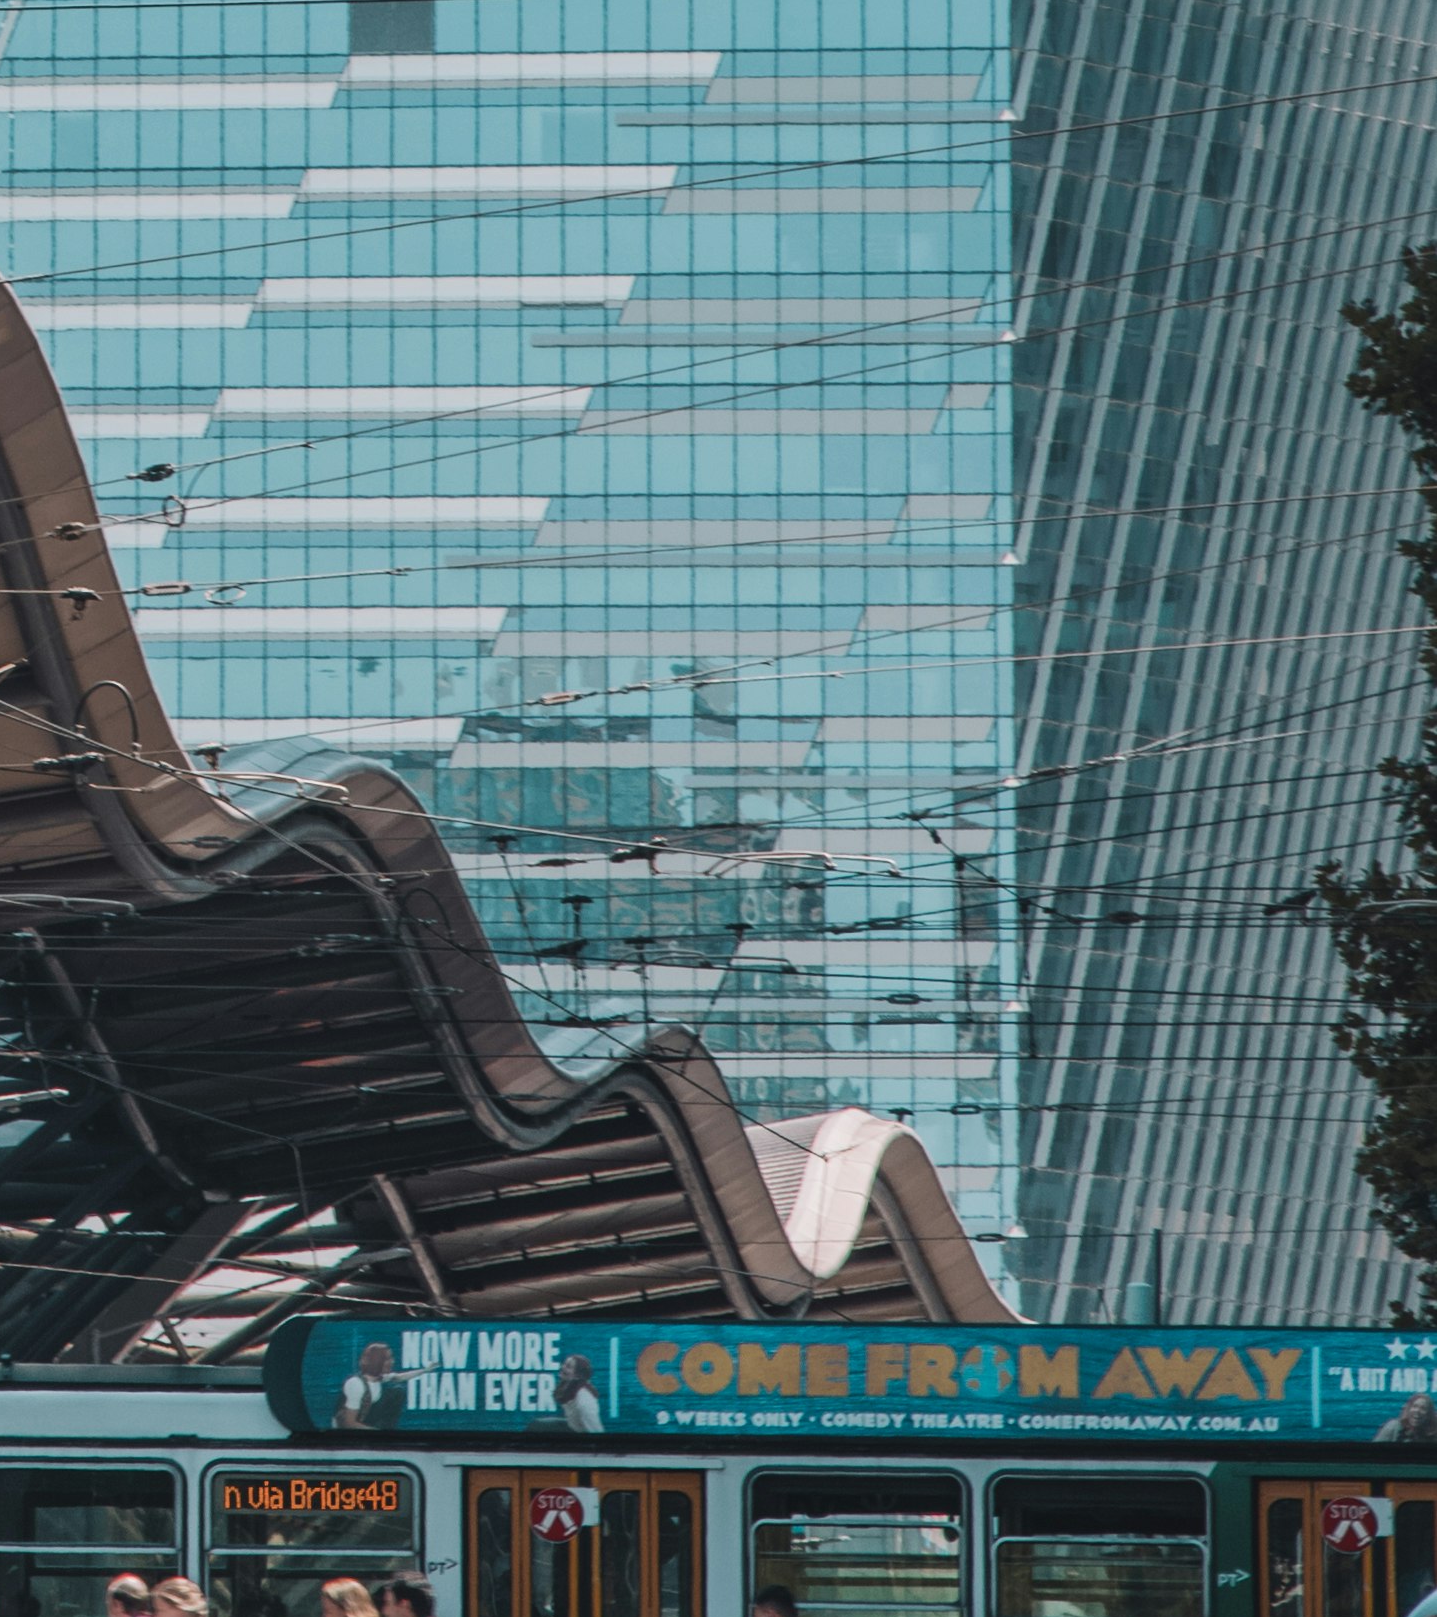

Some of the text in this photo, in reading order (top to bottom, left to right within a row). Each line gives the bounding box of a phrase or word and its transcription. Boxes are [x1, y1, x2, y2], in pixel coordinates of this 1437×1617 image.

[402, 1330, 561, 1371] NOW MORE
[636, 1341, 1303, 1401] COME FROM AWAY
[1357, 1368, 1388, 1392] HIT
[1390, 1368, 1429, 1392] AND
[406, 1372, 557, 1412] THAN EVER
[656, 1411, 1279, 1432] 9 WEEKS ONLY COMEDY THEATRE COMEFROMAWAY.COM.AU
[247, 1480, 284, 1510] via
[537, 1495, 576, 1509] STOP
[1330, 1505, 1370, 1519] STOP
